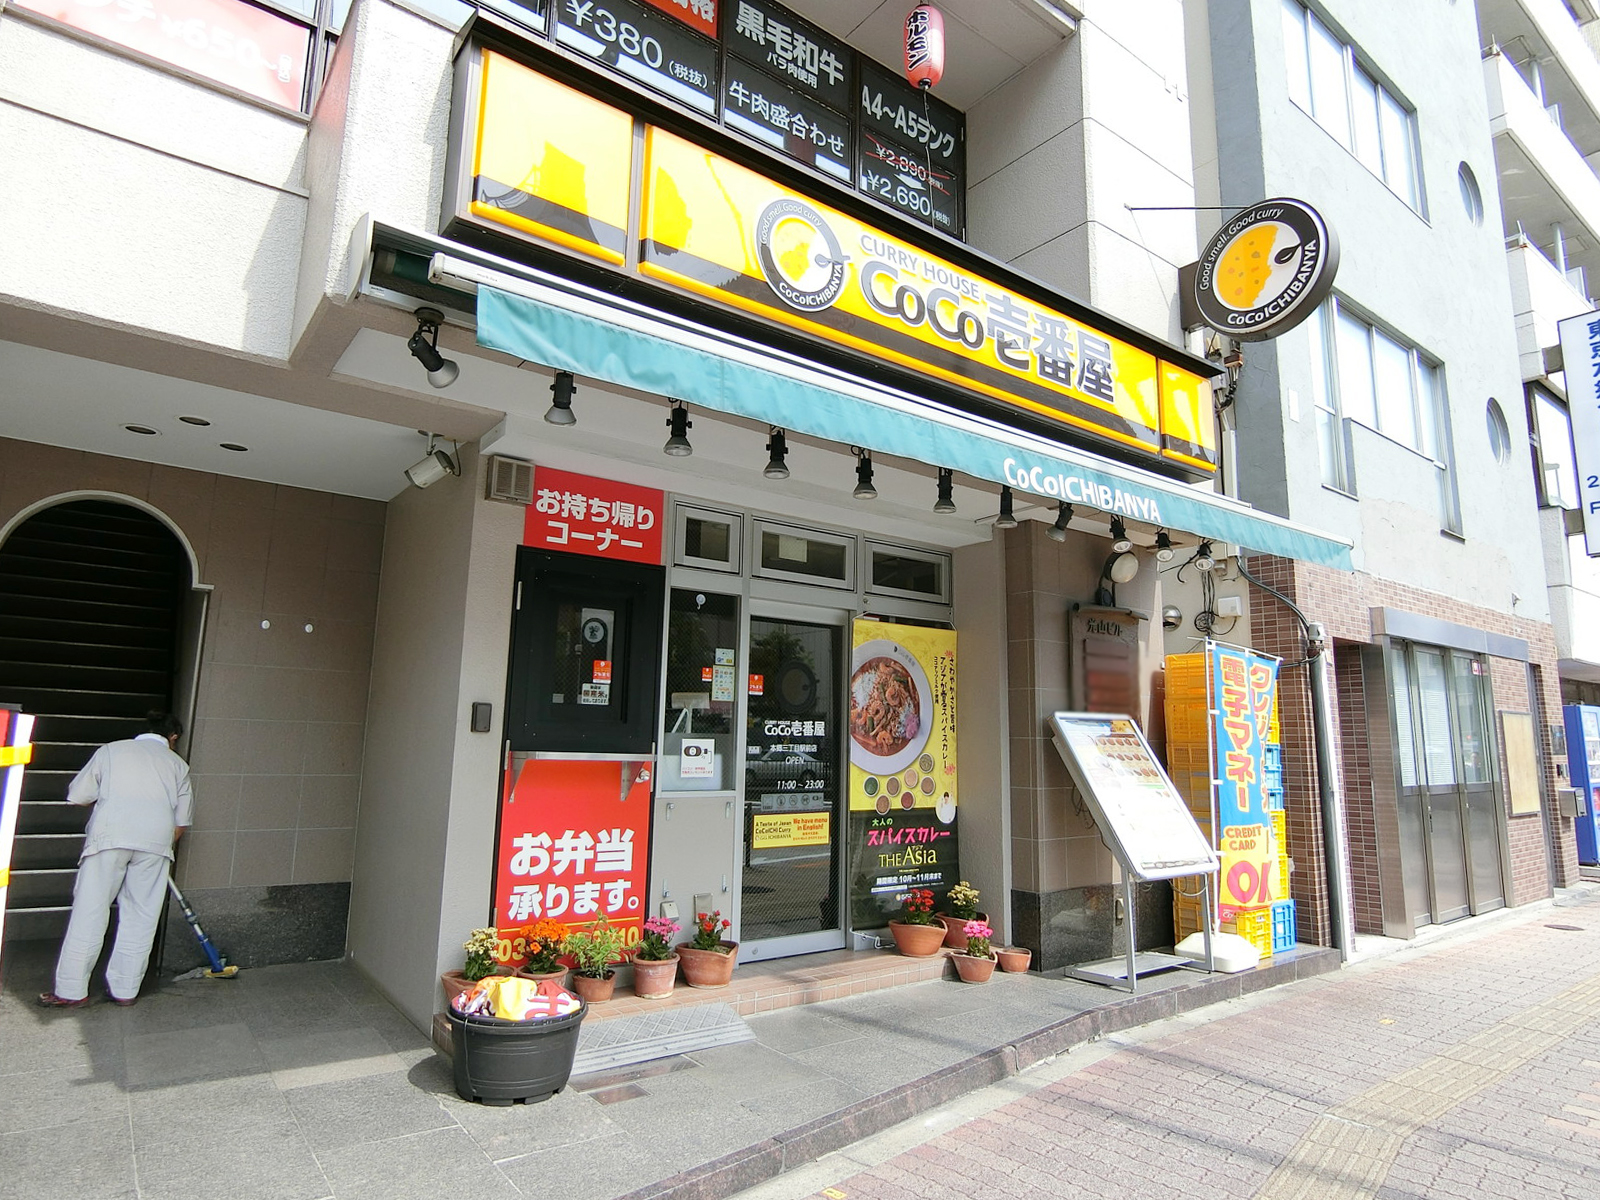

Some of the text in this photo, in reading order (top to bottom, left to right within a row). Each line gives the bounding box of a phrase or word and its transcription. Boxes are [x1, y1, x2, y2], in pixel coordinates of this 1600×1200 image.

[735, 1, 844, 86] 黒毛和牛
[906, 9, 930, 71] ホルモン
[767, 51, 818, 89] バラ肉使用
[728, 80, 845, 158] 牛肉盛合わせ
[783, 203, 803, 214] Good
[803, 208, 823, 227] curry
[867, 170, 931, 217] ¥2,690
[860, 233, 980, 301] CURRY HOUSE
[1199, 263, 1212, 291] Good
[1228, 210, 1255, 236] Good
[1256, 208, 1285, 220] curry
[1227, 239, 1317, 325] CoCoICHIBANYA
[859, 261, 1115, 403] CoCo壱番屋
[535, 488, 655, 531] お持ち帰り
[1003, 457, 1162, 524] CoCoICHIBANYA
[546, 520, 644, 552] コーナー
[764, 720, 826, 737] CoCo壱番屋
[1220, 654, 1256, 813] 電子マネー
[785, 756, 805, 765] OPEN
[777, 780, 797, 790] 11:00
[804, 780, 825, 789] 23:00
[867, 826, 951, 847] スパイスカレー
[872, 817, 893, 827] 大人の
[1225, 825, 1262, 838] CREDIT
[509, 827, 635, 876] お弁当
[879, 845, 937, 867] THE Asia
[1229, 839, 1256, 851] CARD
[507, 878, 640, 921] 承ります。
